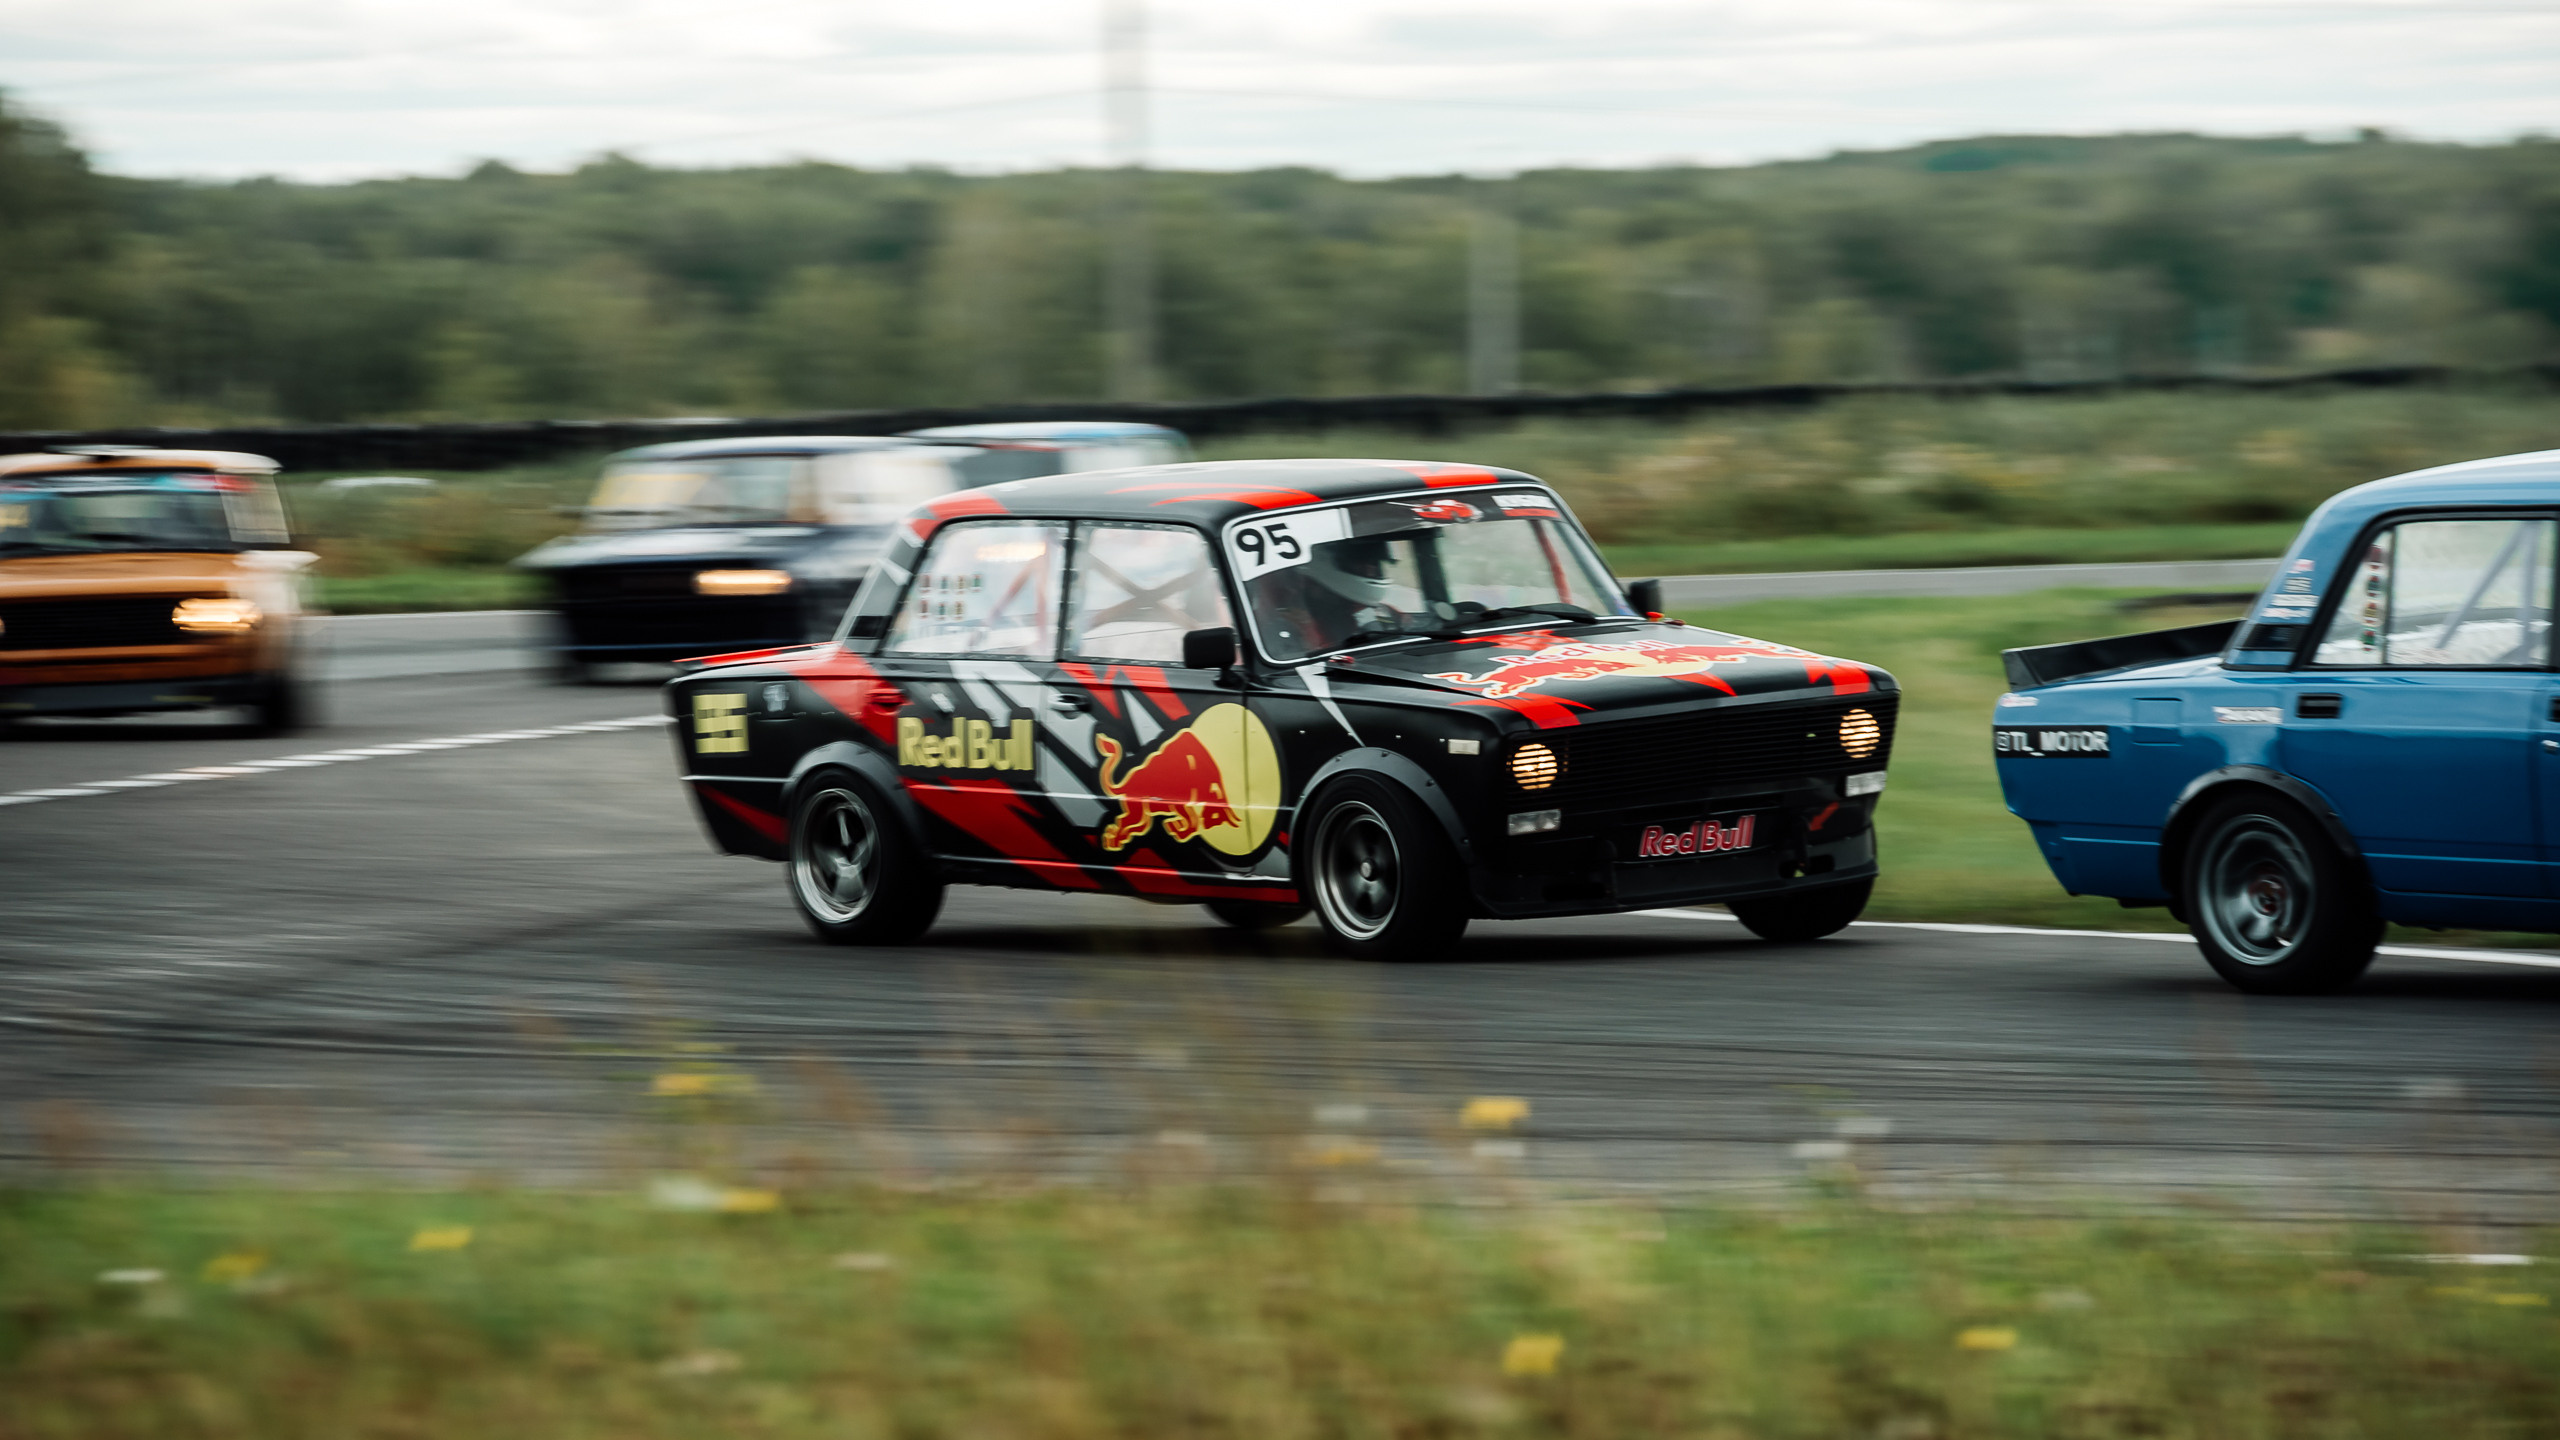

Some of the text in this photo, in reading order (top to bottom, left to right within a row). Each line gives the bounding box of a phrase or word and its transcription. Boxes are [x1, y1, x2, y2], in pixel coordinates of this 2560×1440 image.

[1236, 523, 1302, 567] 95
[897, 716, 1035, 771] Red Bull
[1638, 814, 1756, 857] Red Bull
